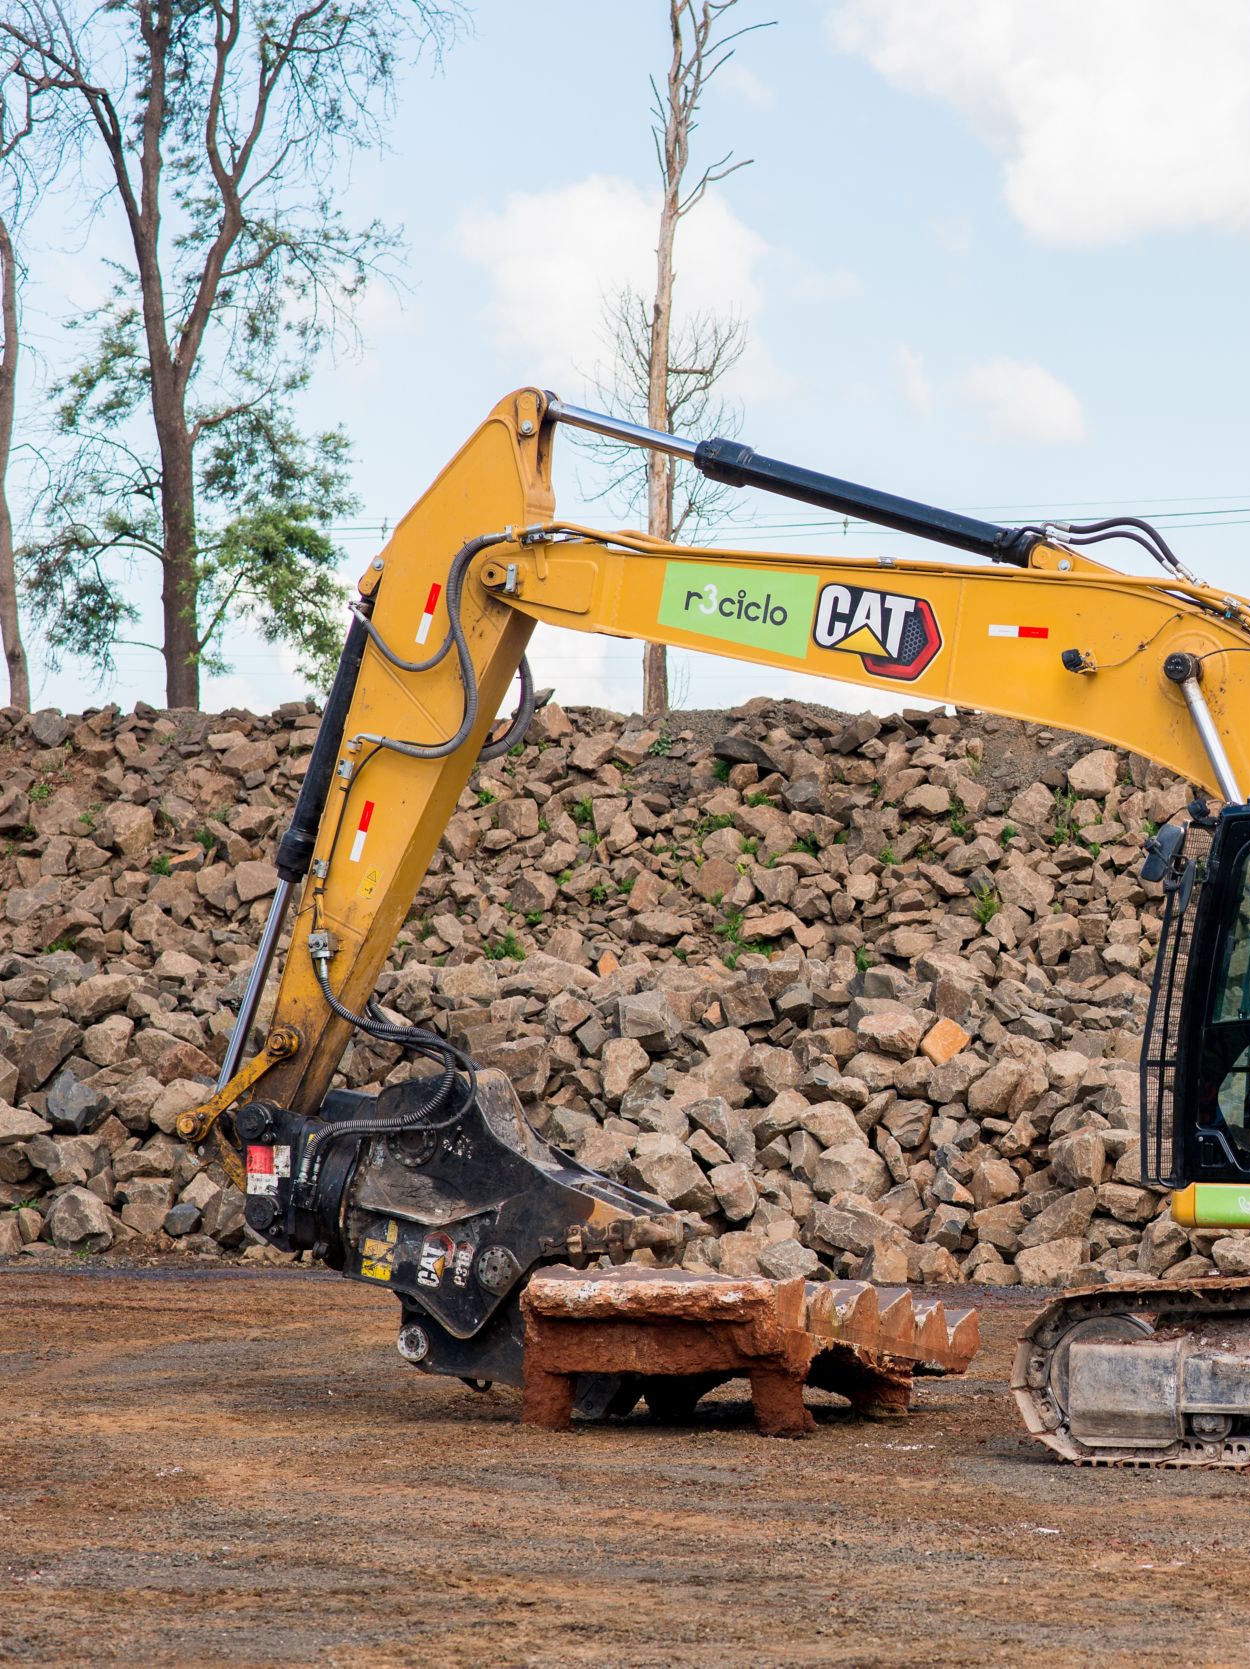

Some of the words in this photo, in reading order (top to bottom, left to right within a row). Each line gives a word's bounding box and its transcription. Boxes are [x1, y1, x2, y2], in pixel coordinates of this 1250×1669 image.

[684, 583, 788, 626] r3ciclo
[815, 584, 915, 658] CAT
[417, 1241, 446, 1288] CAT
